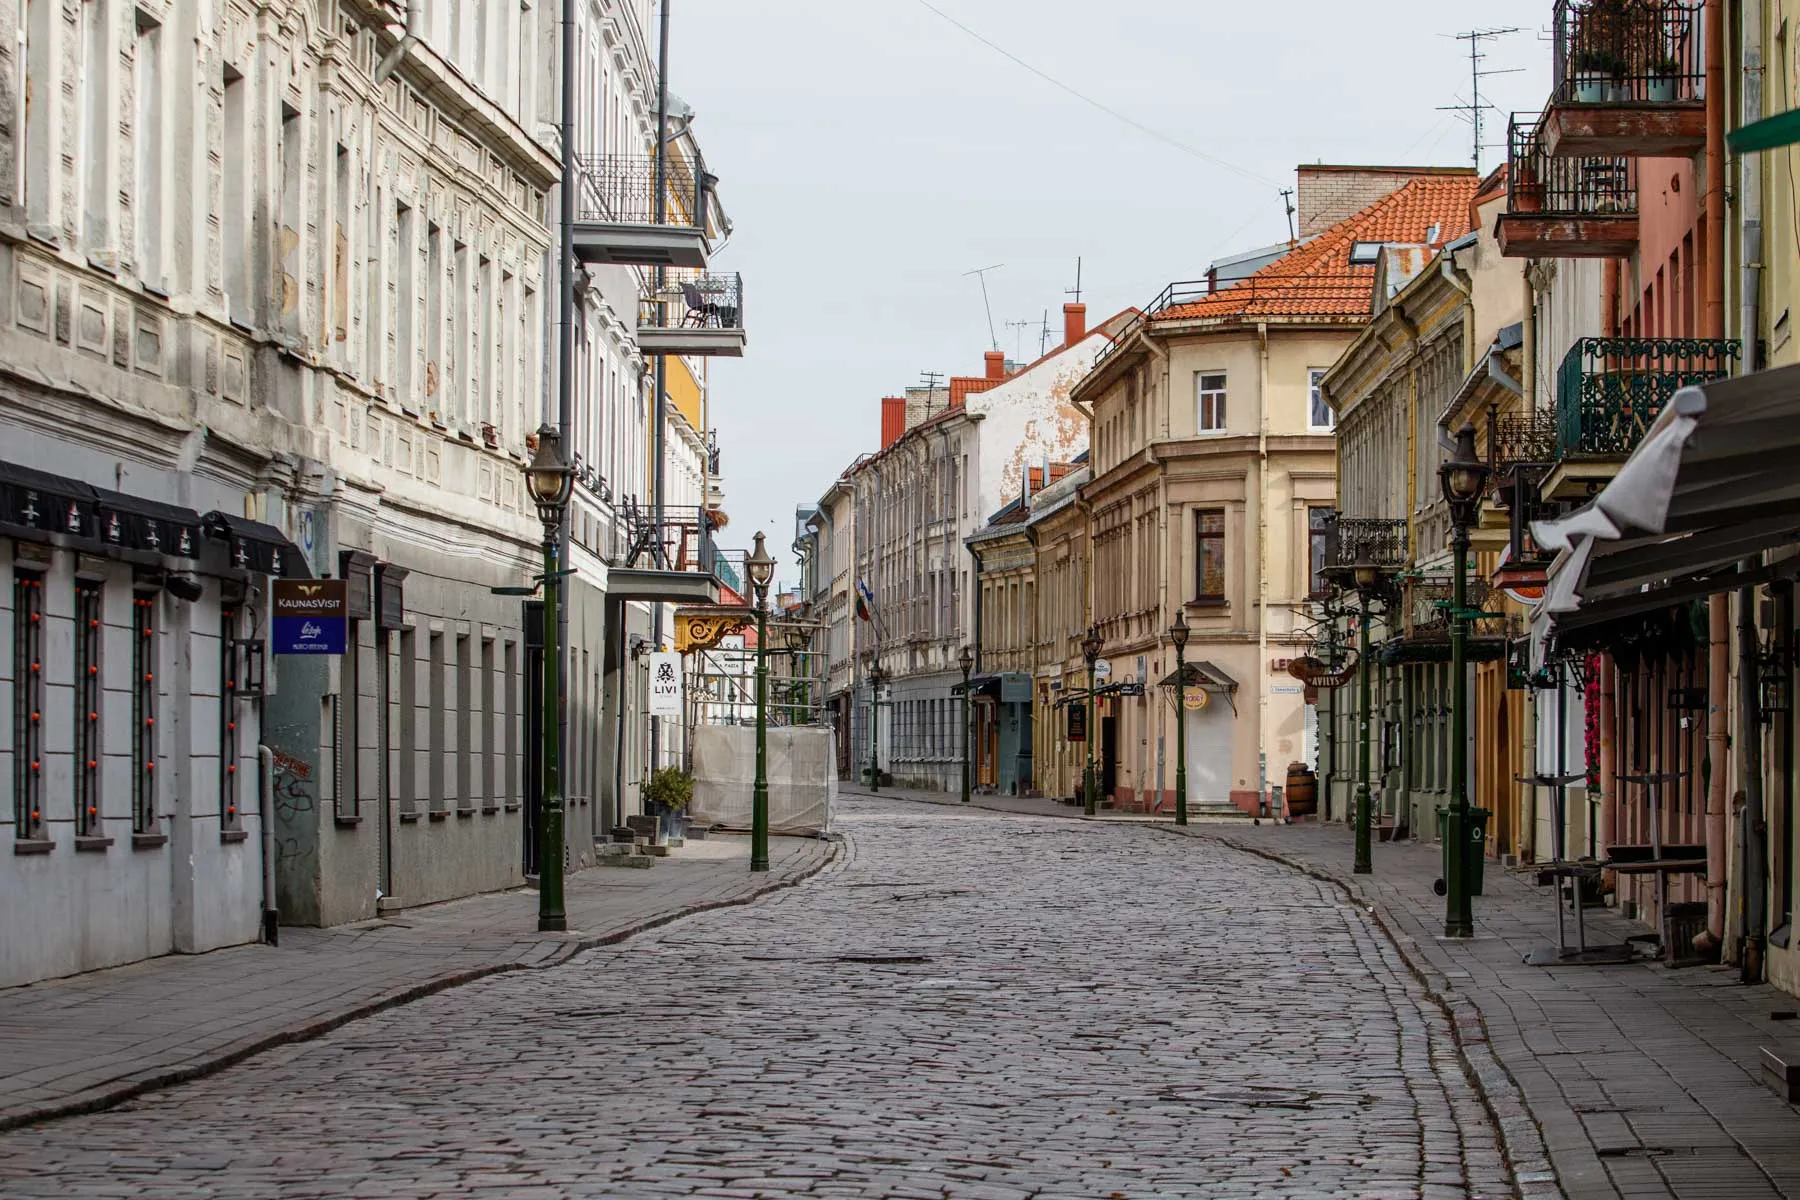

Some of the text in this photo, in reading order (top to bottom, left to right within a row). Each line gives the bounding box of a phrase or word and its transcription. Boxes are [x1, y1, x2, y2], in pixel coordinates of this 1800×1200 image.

[278, 598, 341, 608] KAUNASVISIT
[1312, 676, 1340, 686] AVILYS
[654, 686, 677, 694] LIVI
